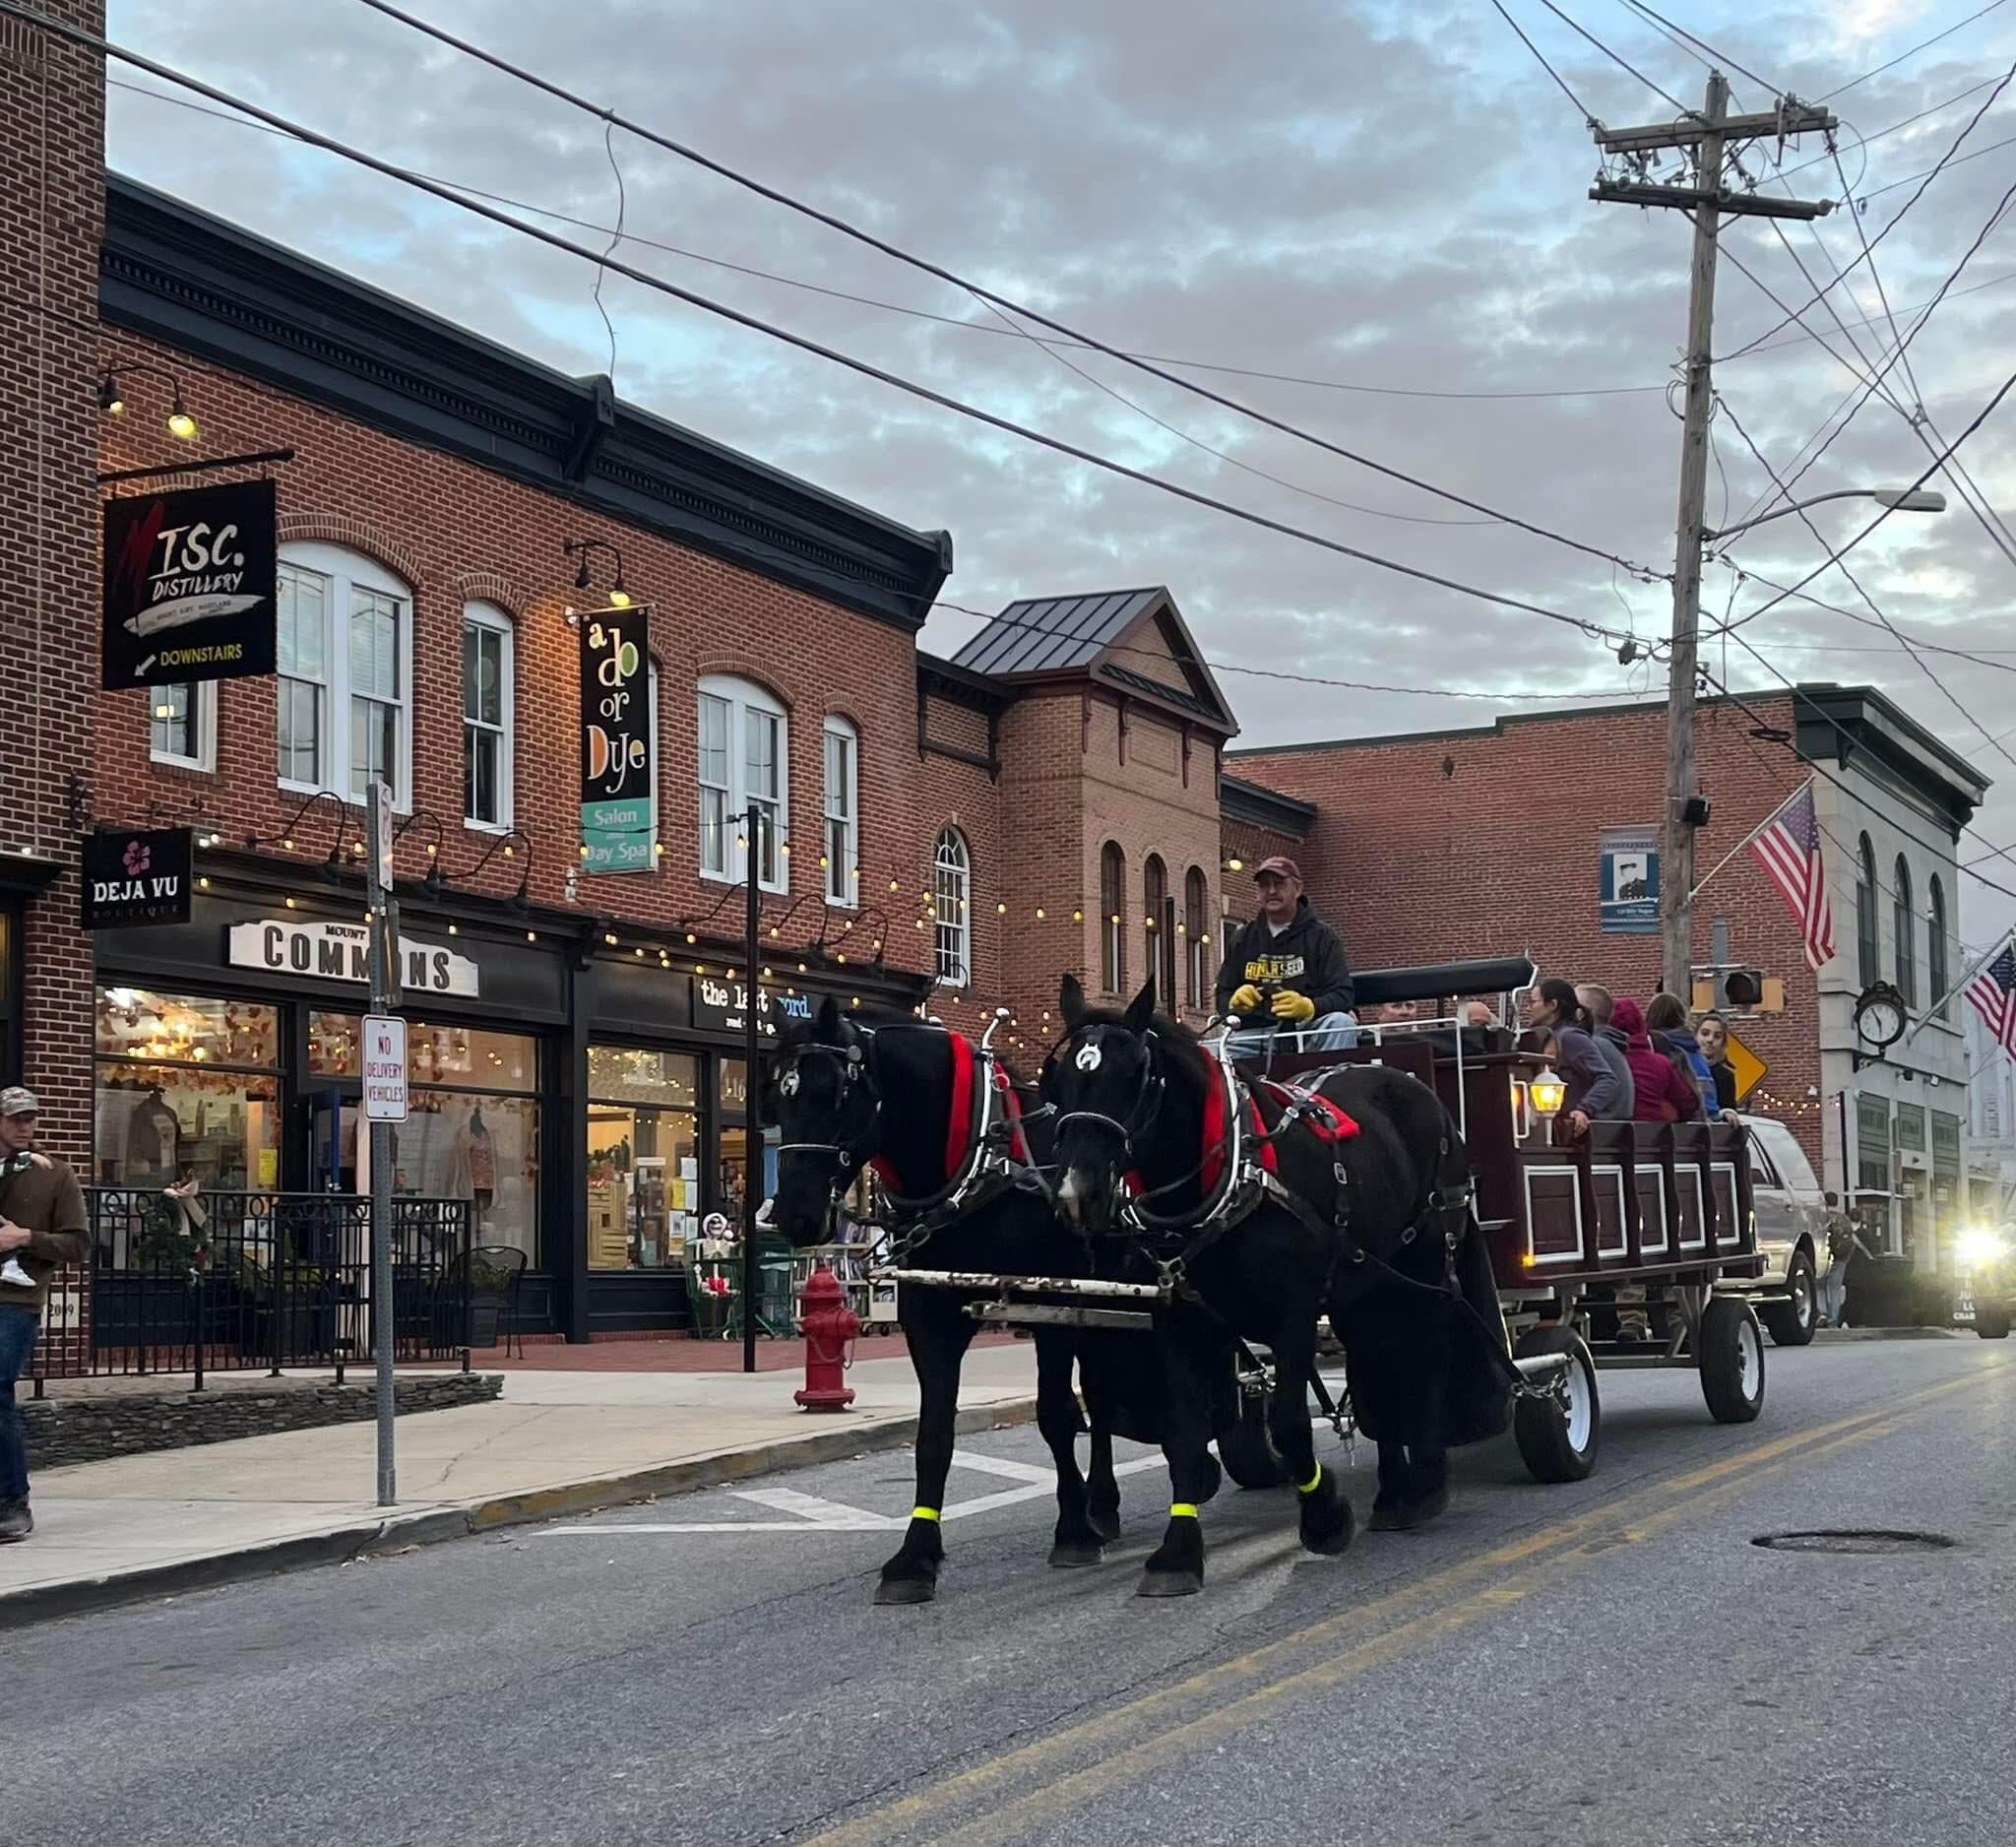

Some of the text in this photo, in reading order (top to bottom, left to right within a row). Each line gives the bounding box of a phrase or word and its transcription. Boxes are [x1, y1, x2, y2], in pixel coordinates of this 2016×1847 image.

[153, 571, 244, 601] DISTILLERY
[589, 622, 607, 649] a
[160, 644, 243, 667] DOWNSTAIRS
[598, 628, 639, 686] do
[599, 691, 630, 722] or
[586, 725, 646, 794] Dye
[594, 808, 637, 826] Salon
[618, 843, 647, 860] Spa
[94, 876, 178, 902] DEJA VU
[326, 924, 366, 940] MOUNT
[264, 925, 450, 989] COMMNS
[701, 980, 728, 1006] the
[734, 986, 768, 1012] lat
[378, 1036, 391, 1055] NO
[367, 1062, 403, 1078] DELIVERY
[368, 1086, 404, 1103] VEHICLES
[48, 1304, 74, 1316] 209
